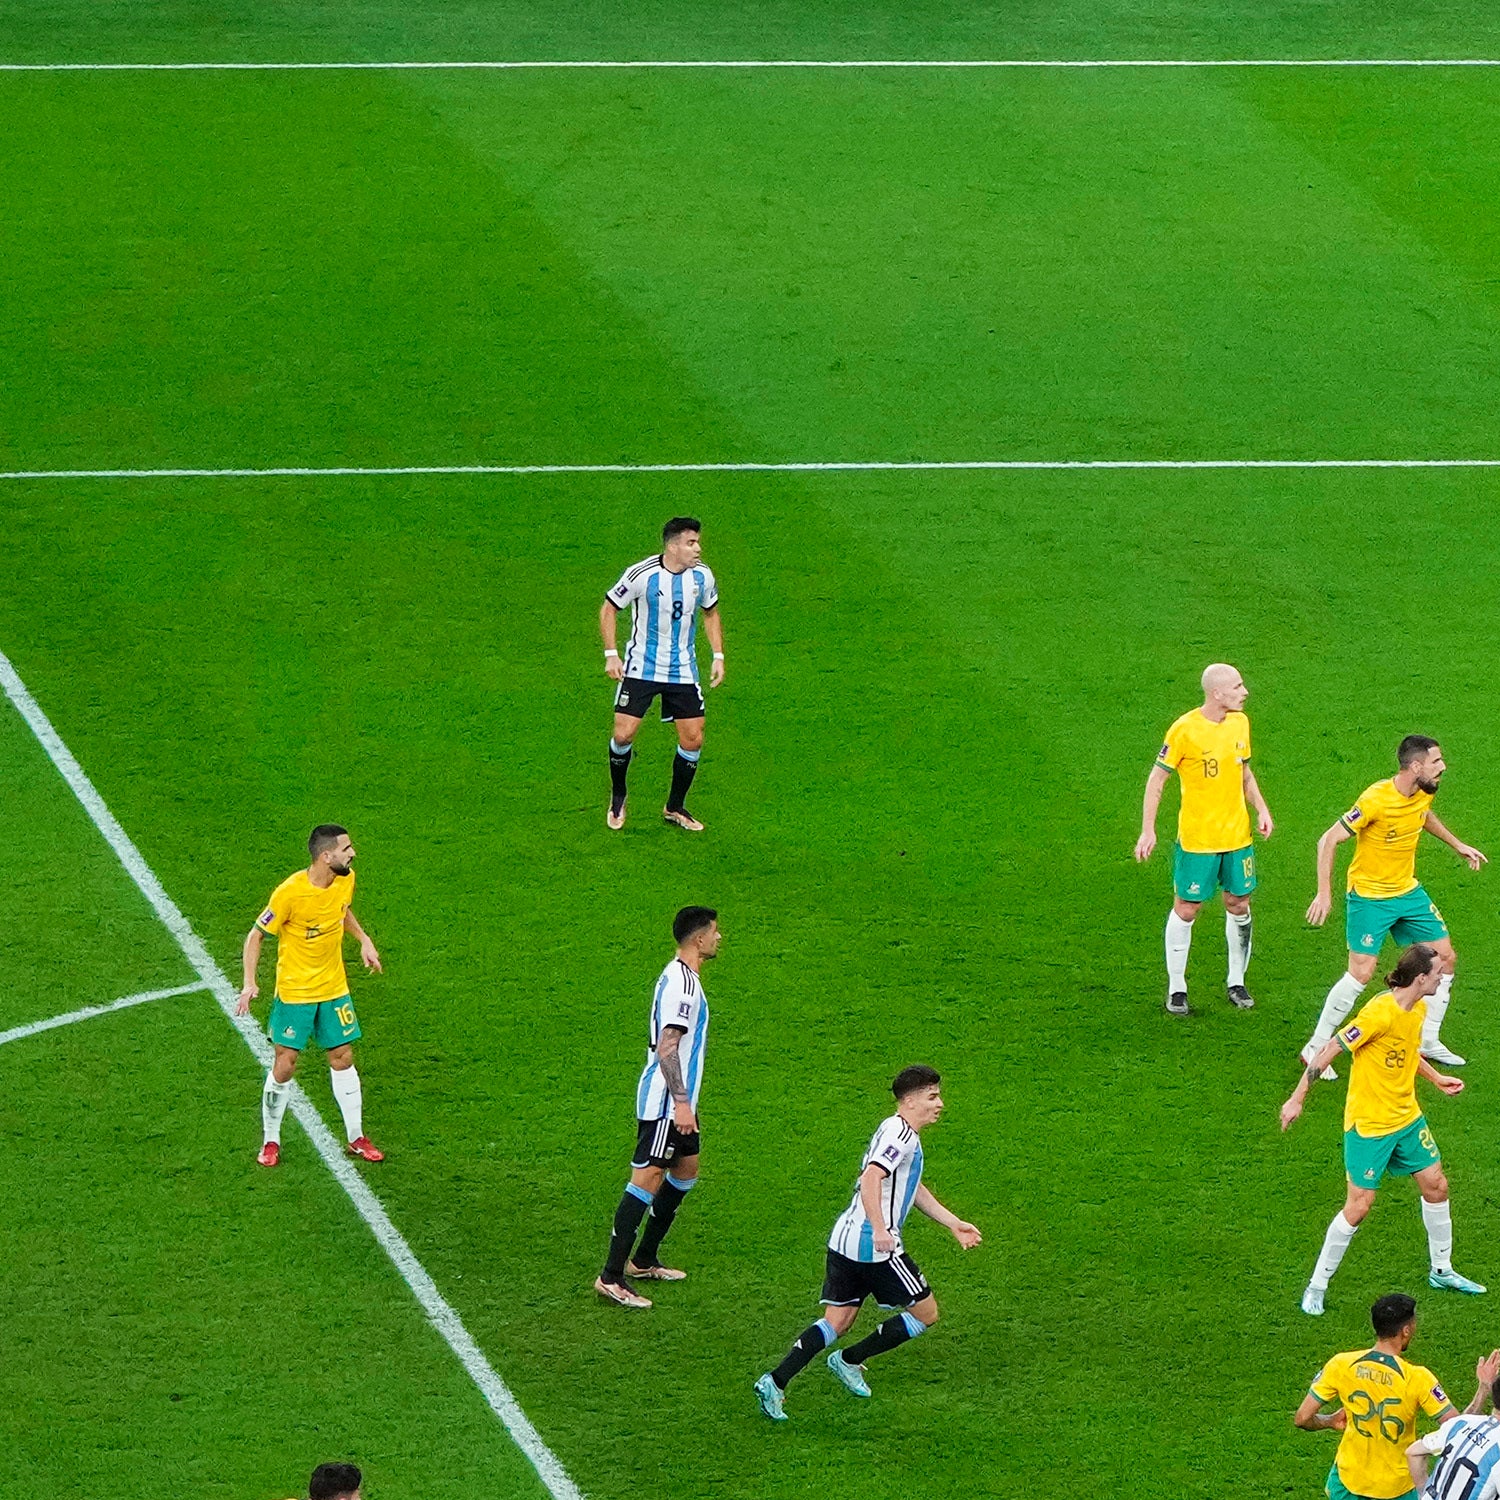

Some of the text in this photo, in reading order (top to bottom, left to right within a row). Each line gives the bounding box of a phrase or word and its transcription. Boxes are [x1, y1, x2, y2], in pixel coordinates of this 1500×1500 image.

[671, 600, 683, 621] 8
[1202, 758, 1219, 778] 13
[334, 1003, 355, 1027] 16
[1348, 1390, 1405, 1444] 26
